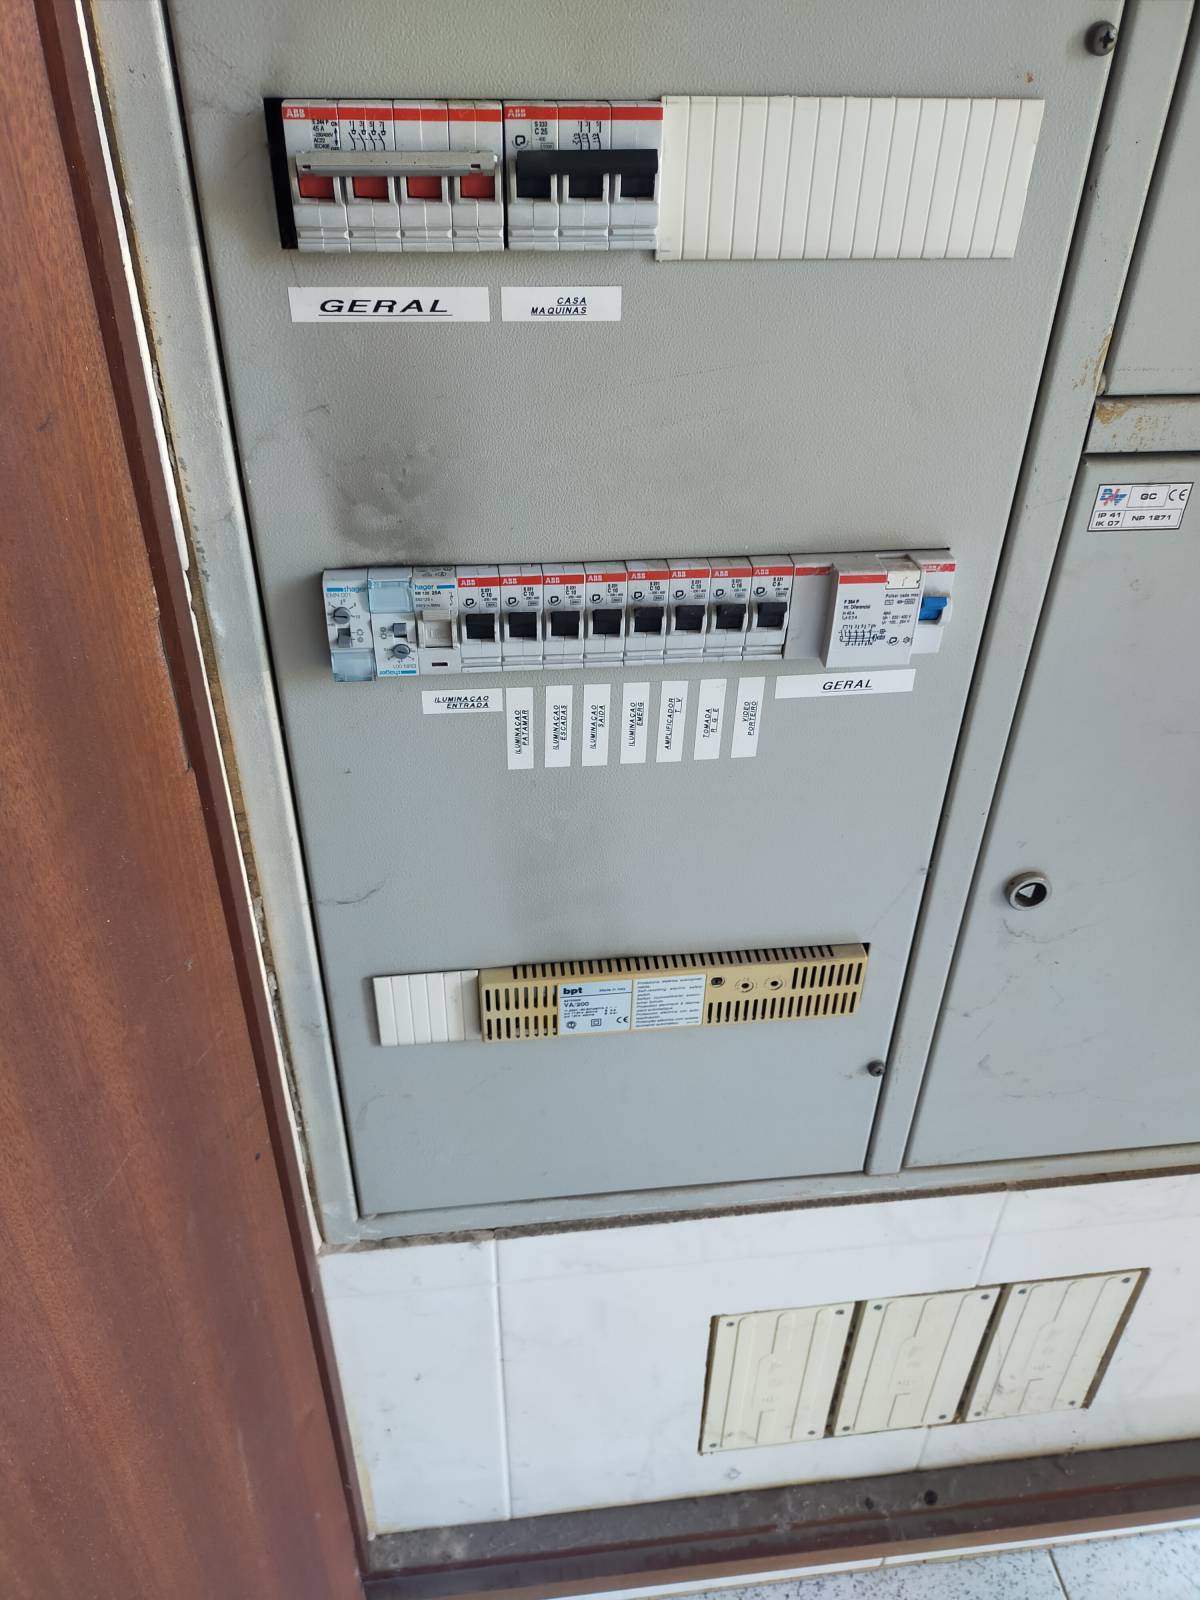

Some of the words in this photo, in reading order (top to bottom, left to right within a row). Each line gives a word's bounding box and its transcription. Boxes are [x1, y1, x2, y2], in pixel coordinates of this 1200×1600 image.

[286, 109, 305, 118] ABB
[508, 109, 526, 117] ABB
[318, 298, 450, 314] GERAL
[556, 296, 587, 306] CASA
[530, 306, 587, 316] MAQUINAS
[1140, 493, 1157, 501] GC
[822, 679, 872, 691] GERAL
[742, 701, 750, 722] VIDEO
[665, 698, 675, 749] AMPLIFICADOR
[703, 709, 711, 738] TOMADA
[748, 701, 757, 736] PORTEIRO
[563, 987, 583, 995] bpt
